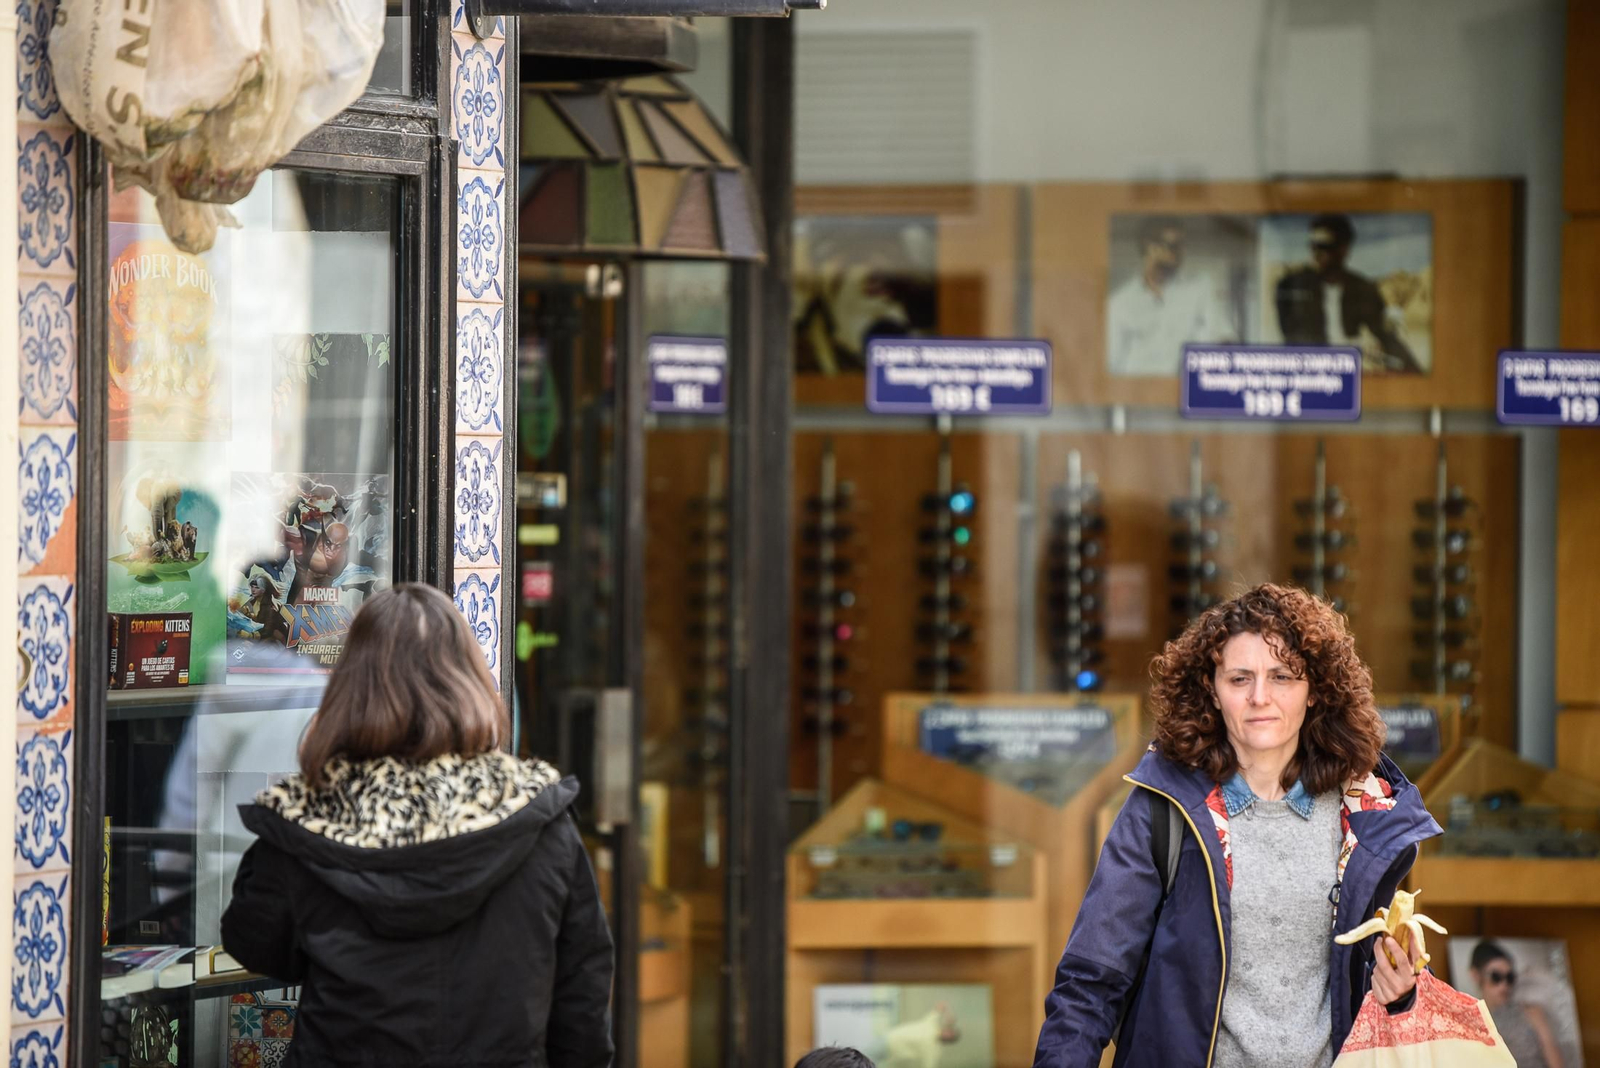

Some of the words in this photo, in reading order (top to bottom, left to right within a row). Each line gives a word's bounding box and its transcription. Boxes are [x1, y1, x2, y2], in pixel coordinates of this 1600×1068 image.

[176, 254, 218, 303] BOOK
[1558, 396, 1599, 422] 169
[303, 588, 338, 601] MARVEL
[131, 619, 163, 633] EXPLODING
[165, 619, 190, 633] KITTENS
[297, 644, 344, 655] INSURREC
